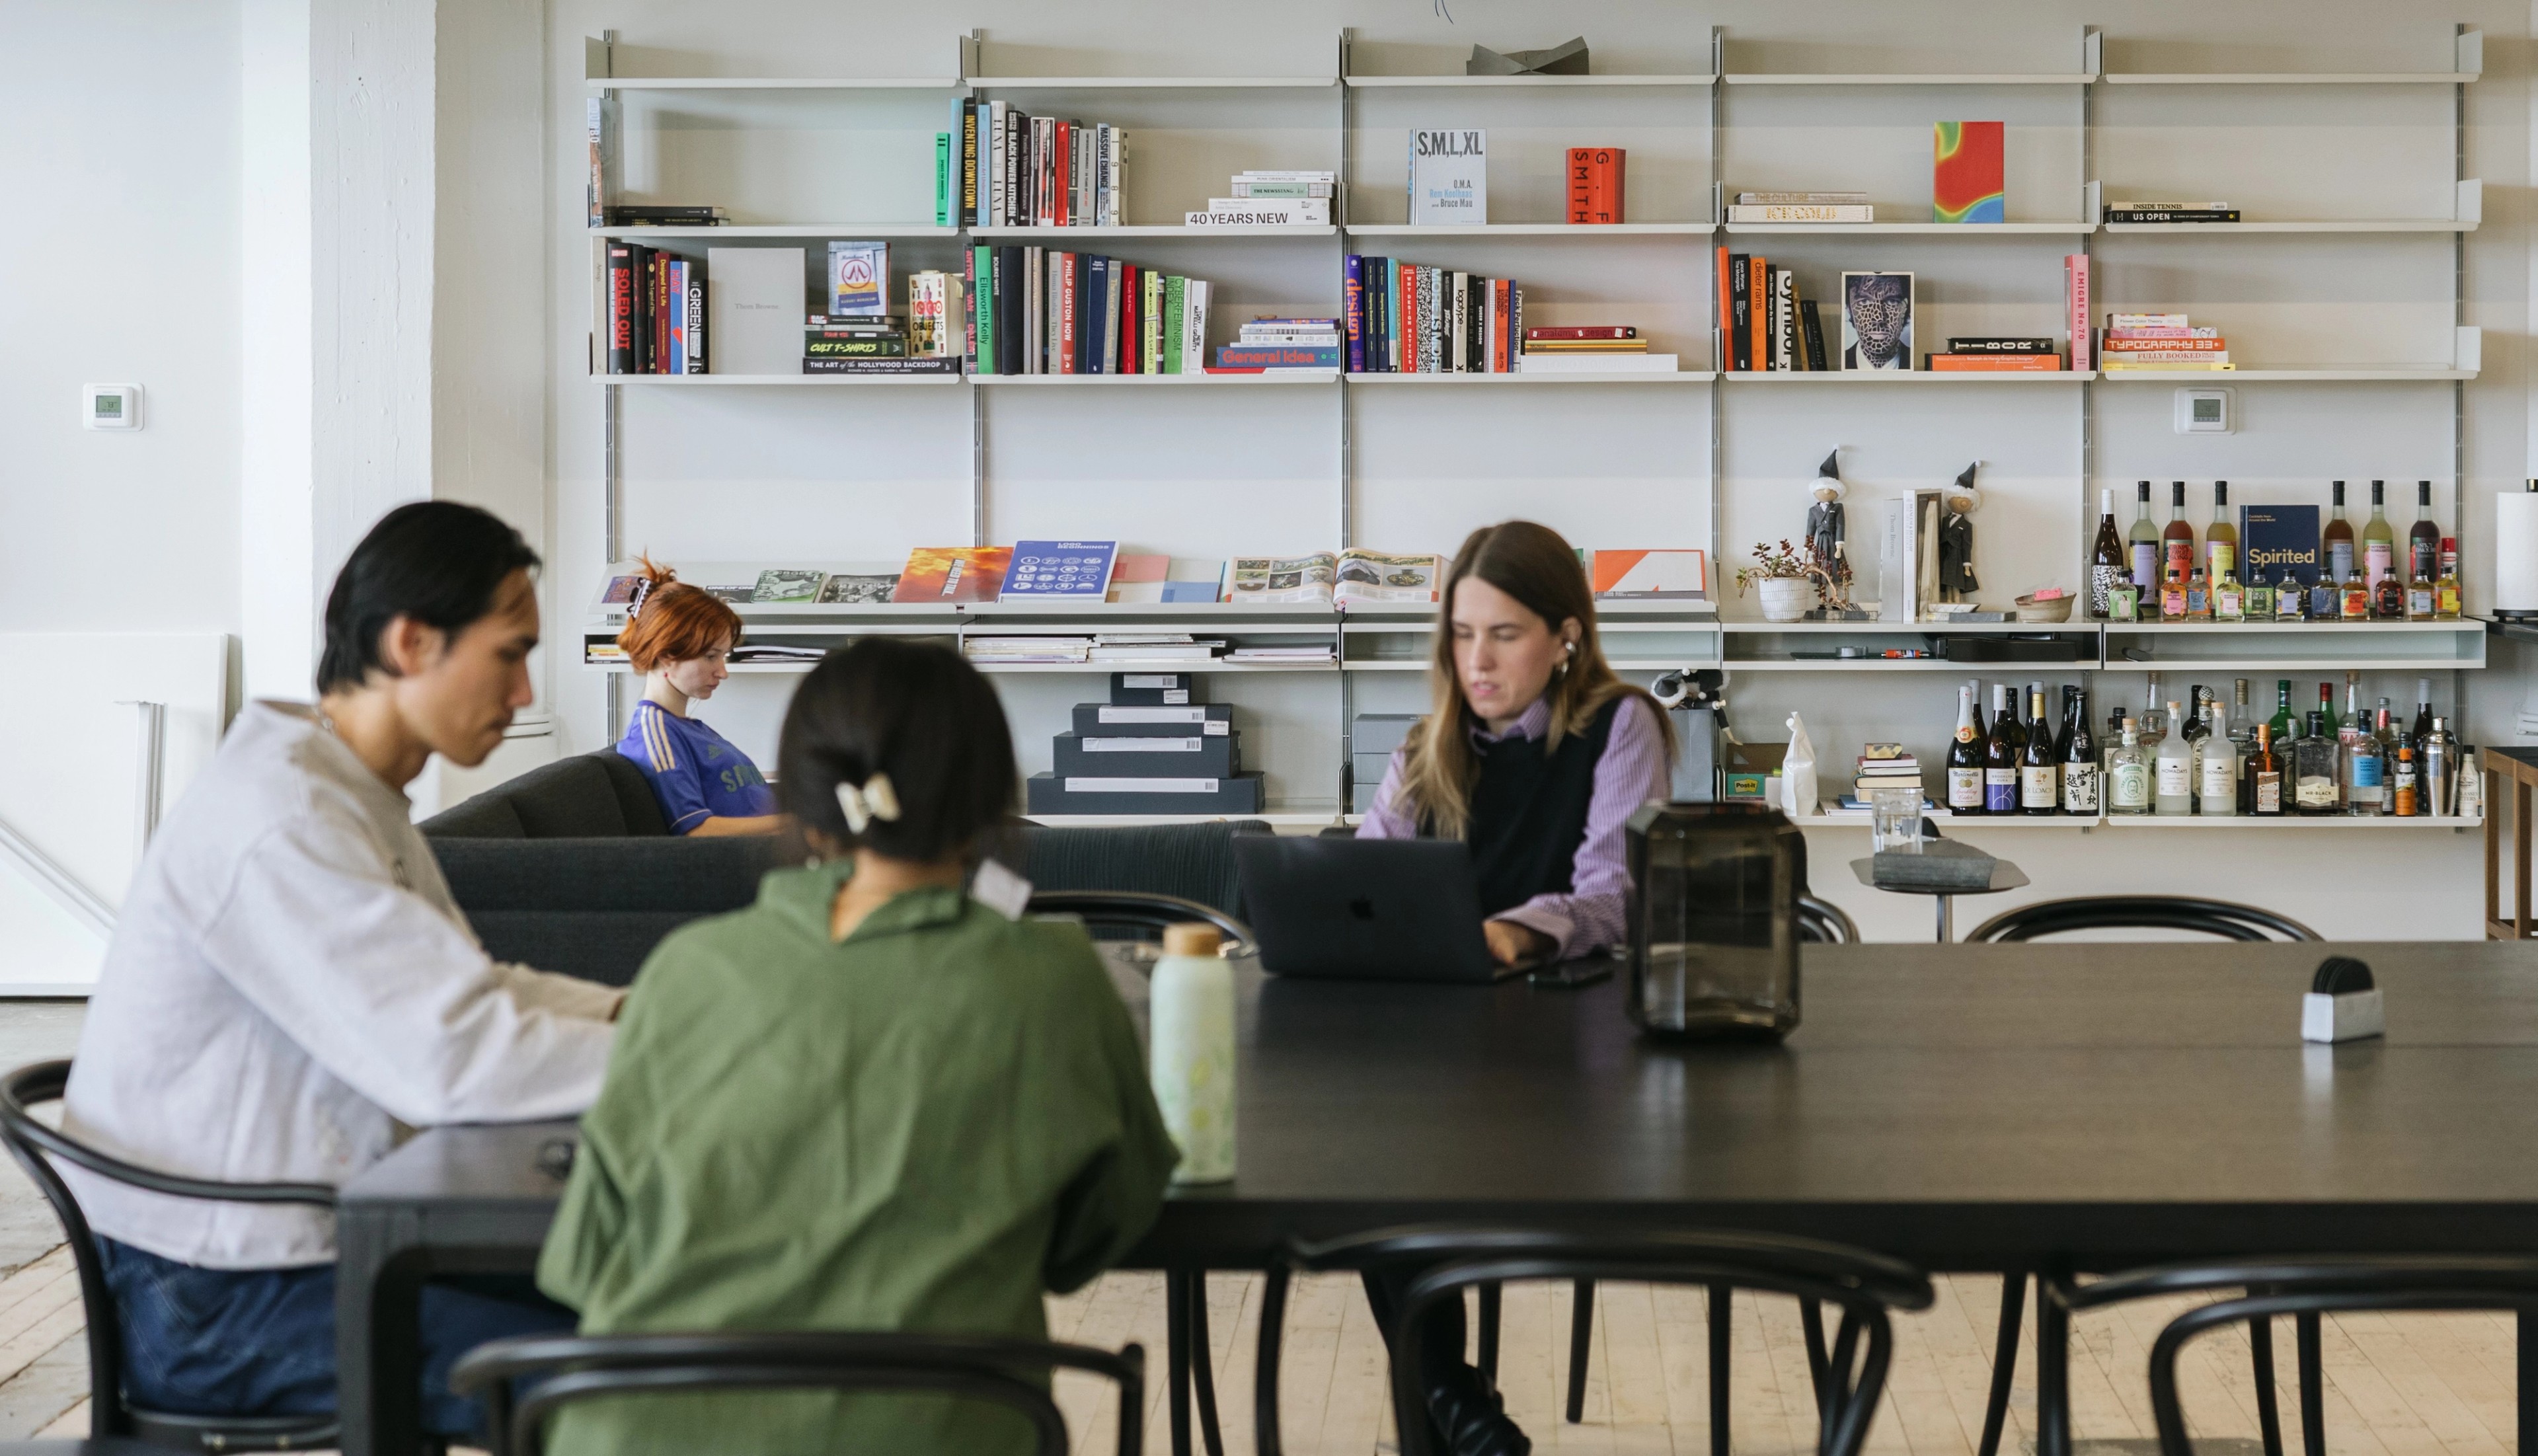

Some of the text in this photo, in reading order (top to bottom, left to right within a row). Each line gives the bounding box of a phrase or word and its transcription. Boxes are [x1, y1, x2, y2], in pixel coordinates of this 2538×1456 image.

[993, 120, 1002, 151] LUNA
[1100, 128, 1109, 160] MASSIVE
[1418, 132, 1483, 158] S,M,L,XL
[964, 115, 976, 209] INVENTING DOWNTOWN
[1008, 132, 1017, 217] BLACK POWER KITCHEN
[1100, 161, 1108, 189] CHANGE
[993, 180, 1002, 211] LUNA
[1430, 189, 1473, 198] Rem Koolhaas
[1454, 180, 1473, 188] O.M.A.
[1575, 152, 1588, 222] SMITH
[1440, 199, 1459, 208] Bruce
[1460, 199, 1473, 208] Mau
[1755, 194, 1770, 202] THE
[1772, 194, 1809, 202] CULTURE
[1190, 212, 1289, 225] 40 YEARS NEW
[1766, 207, 1837, 219] ICE COLD
[966, 250, 974, 282] ANTON
[1755, 262, 1763, 287] dieter
[672, 270, 681, 295] HAY
[1165, 278, 1174, 305] INDEX
[617, 268, 631, 350] SOLED OUT
[690, 288, 702, 331] GREEN
[979, 277, 989, 344] Ellsworth Kelly
[1173, 278, 1183, 351] CYBERFEMINISM
[1346, 278, 1363, 341] design
[1455, 289, 1465, 325] logotype
[912, 322, 944, 331] OBJECTS
[1432, 315, 1442, 330] IS
[1539, 329, 1613, 338] anatomy design
[810, 343, 878, 352] CULT T-SHIRTS
[1222, 350, 1315, 364] General Idea
[2109, 340, 2193, 349] TYPOGRAPHY
[2249, 549, 2315, 567] Spirited
